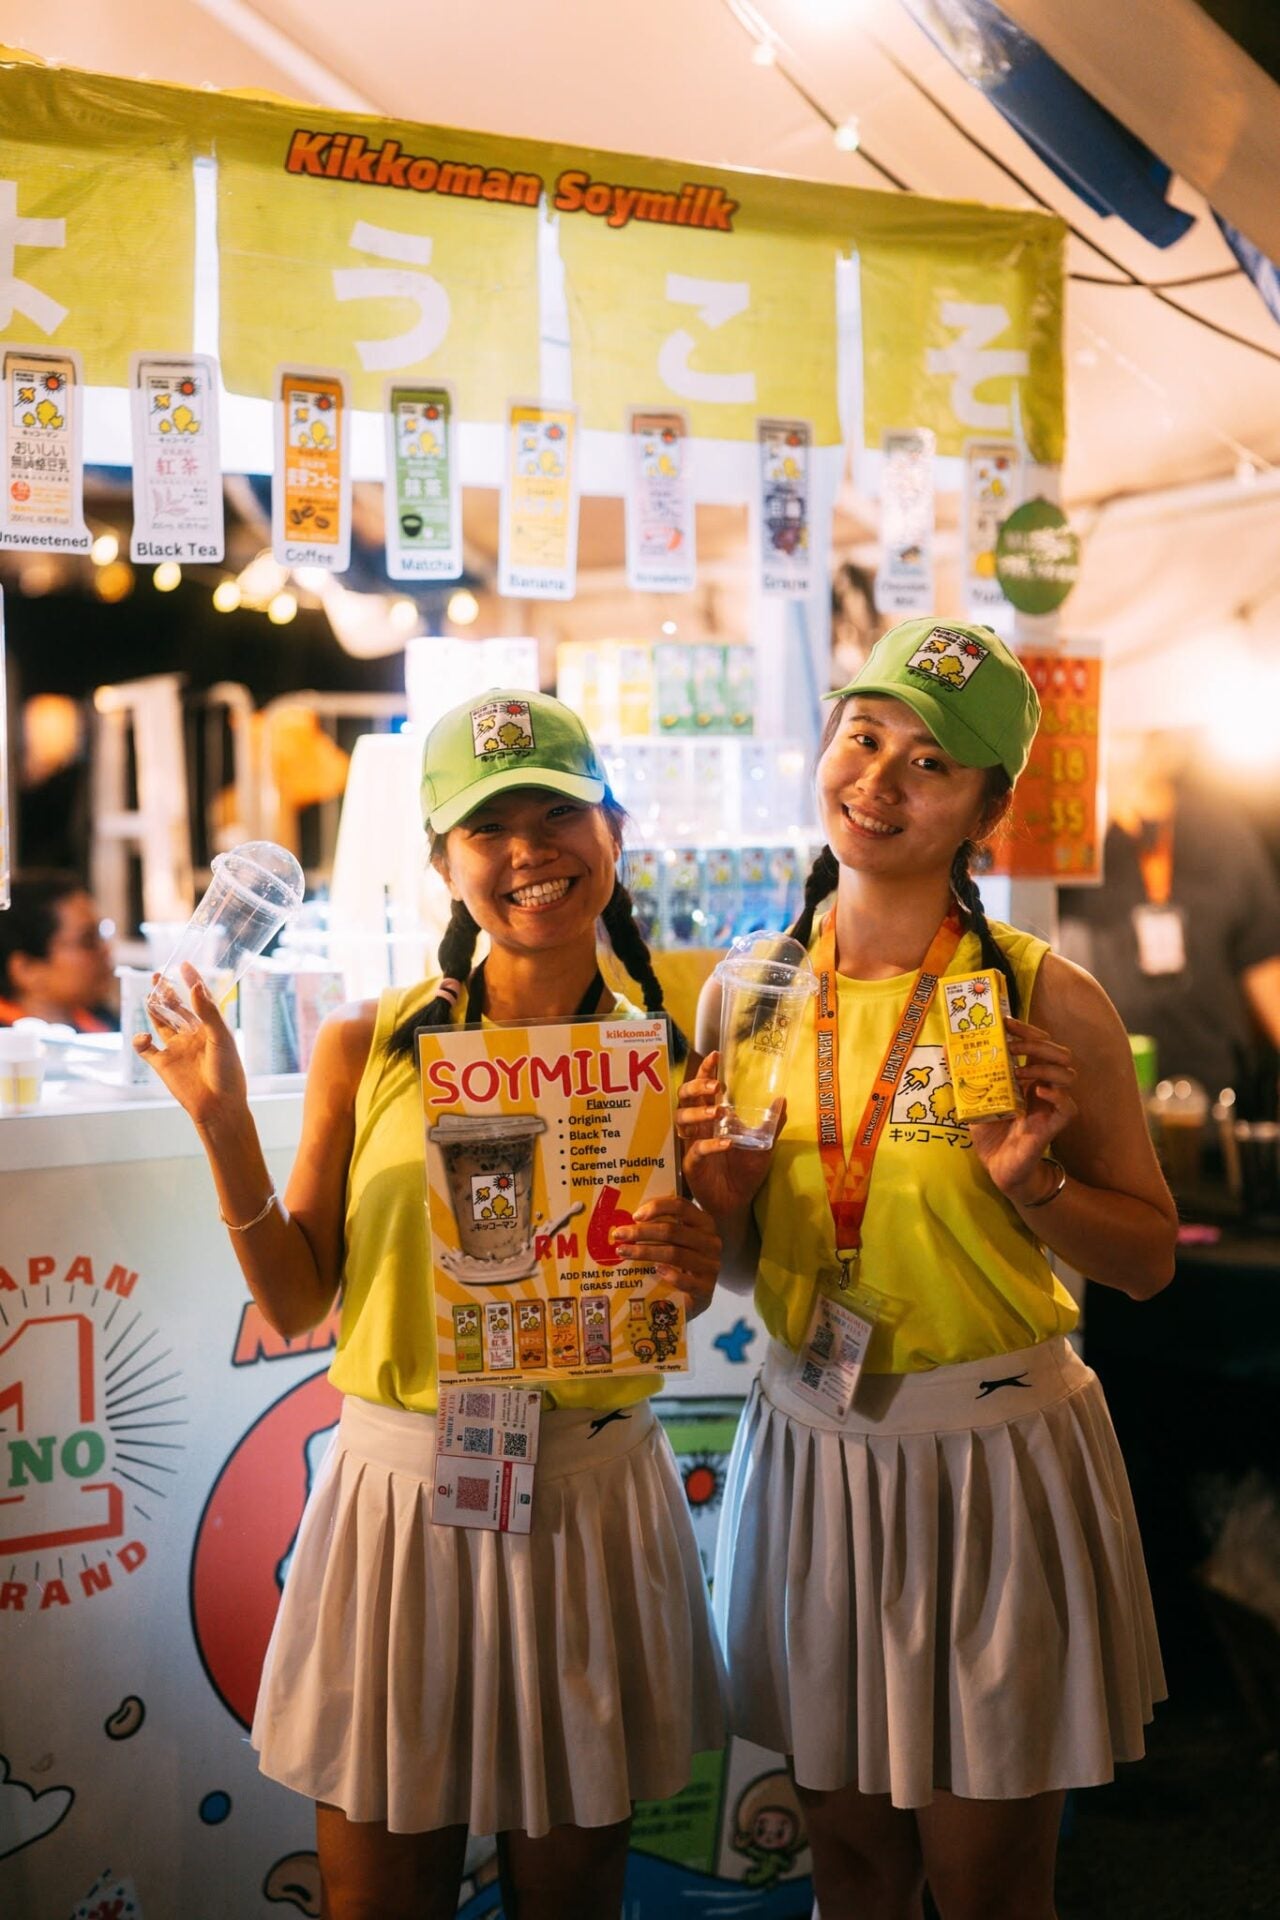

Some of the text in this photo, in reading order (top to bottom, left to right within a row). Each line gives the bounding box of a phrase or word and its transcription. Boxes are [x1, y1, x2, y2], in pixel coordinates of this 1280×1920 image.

[285, 129, 740, 233] Kikkoman Soymilk
[14, 442, 66, 457] おいしい
[137, 543, 218, 556] Black Tea
[285, 549, 334, 565] Coffee
[401, 558, 454, 572] Matcha
[510, 575, 565, 590] Banana
[914, 973, 938, 1003] SAUCE
[906, 1004, 924, 1023] SOY
[606, 1030, 657, 1039] kikkoman
[429, 1050, 664, 1104] SOYMILK
[820, 1091, 834, 1110] SOY
[568, 1113, 611, 1126] Original
[570, 1129, 621, 1140] Black Tea
[821, 1113, 837, 1145] SAUCE
[889, 1128, 973, 1149] キッコーマン
[570, 1145, 607, 1156] Coffee
[571, 1157, 665, 1171] Caremel Pudding
[572, 1173, 640, 1187] White Peach
[534, 1185, 637, 1267] RM 6
[560, 1266, 657, 1280] ADD RM1 for TOPPING
[580, 1279, 643, 1291] (GRASS JELLY)
[7, 1430, 106, 1487] NO
